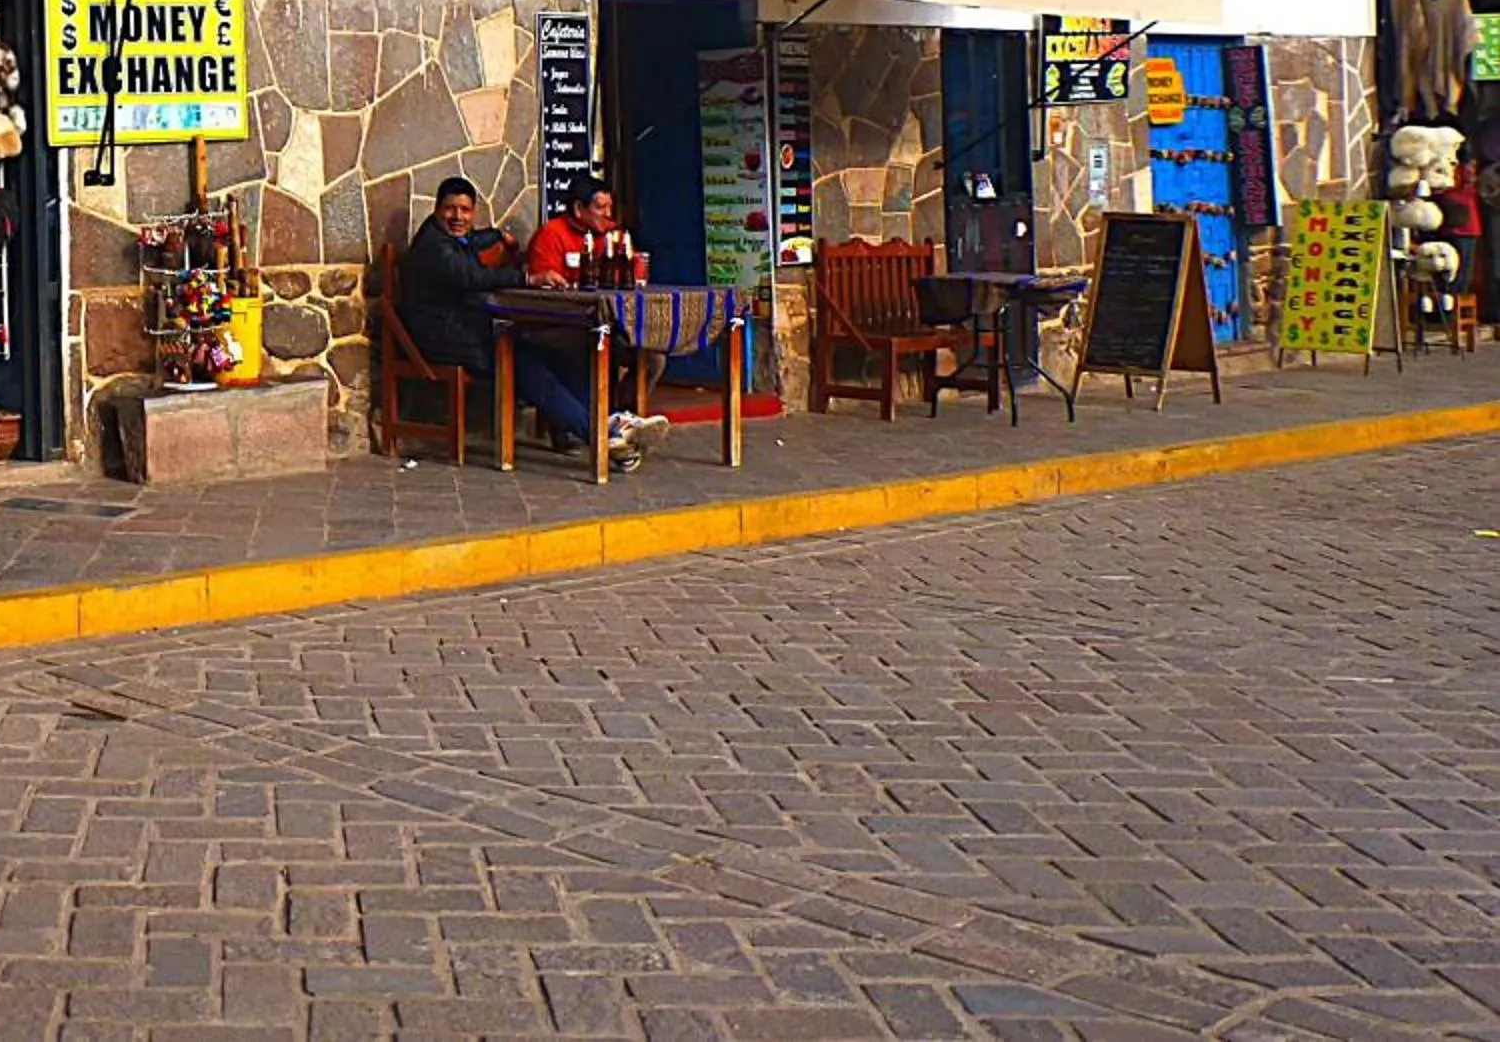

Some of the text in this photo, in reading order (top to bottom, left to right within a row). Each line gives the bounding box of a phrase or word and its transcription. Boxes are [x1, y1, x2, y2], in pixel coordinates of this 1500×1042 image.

[89, 4, 207, 42] MONEY
[541, 19, 585, 45] Cafeteria
[58, 56, 238, 95] EXCHANGE
[1299, 215, 1330, 332] MONEY
[1332, 215, 1364, 335] EXCHANGE
